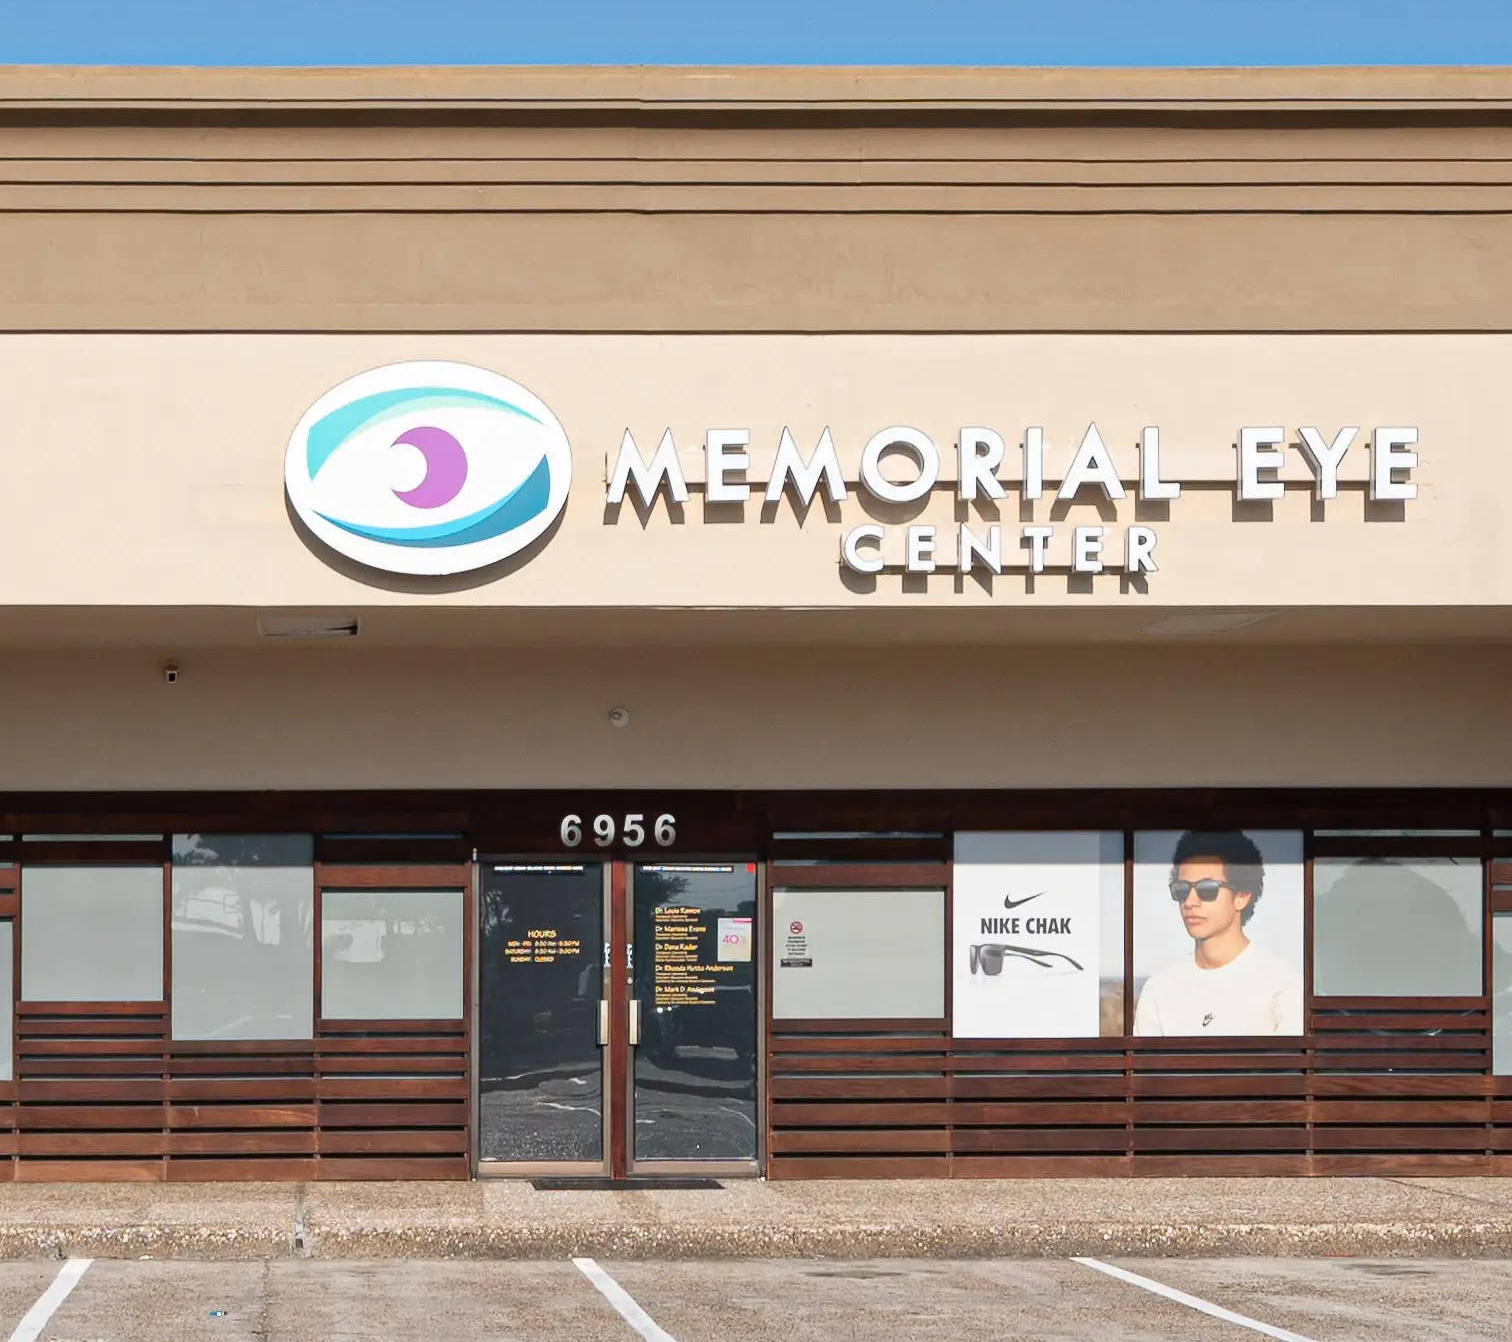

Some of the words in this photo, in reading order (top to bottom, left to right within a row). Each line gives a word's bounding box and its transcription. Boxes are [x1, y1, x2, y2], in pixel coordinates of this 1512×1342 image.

[607, 423, 1181, 503] MEMORIAL
[1238, 424, 1420, 501] EYE
[842, 524, 1158, 574] CENTER
[560, 813, 676, 847] 6956
[980, 917, 1020, 934] NIKE
[1025, 917, 1072, 934] CHAK
